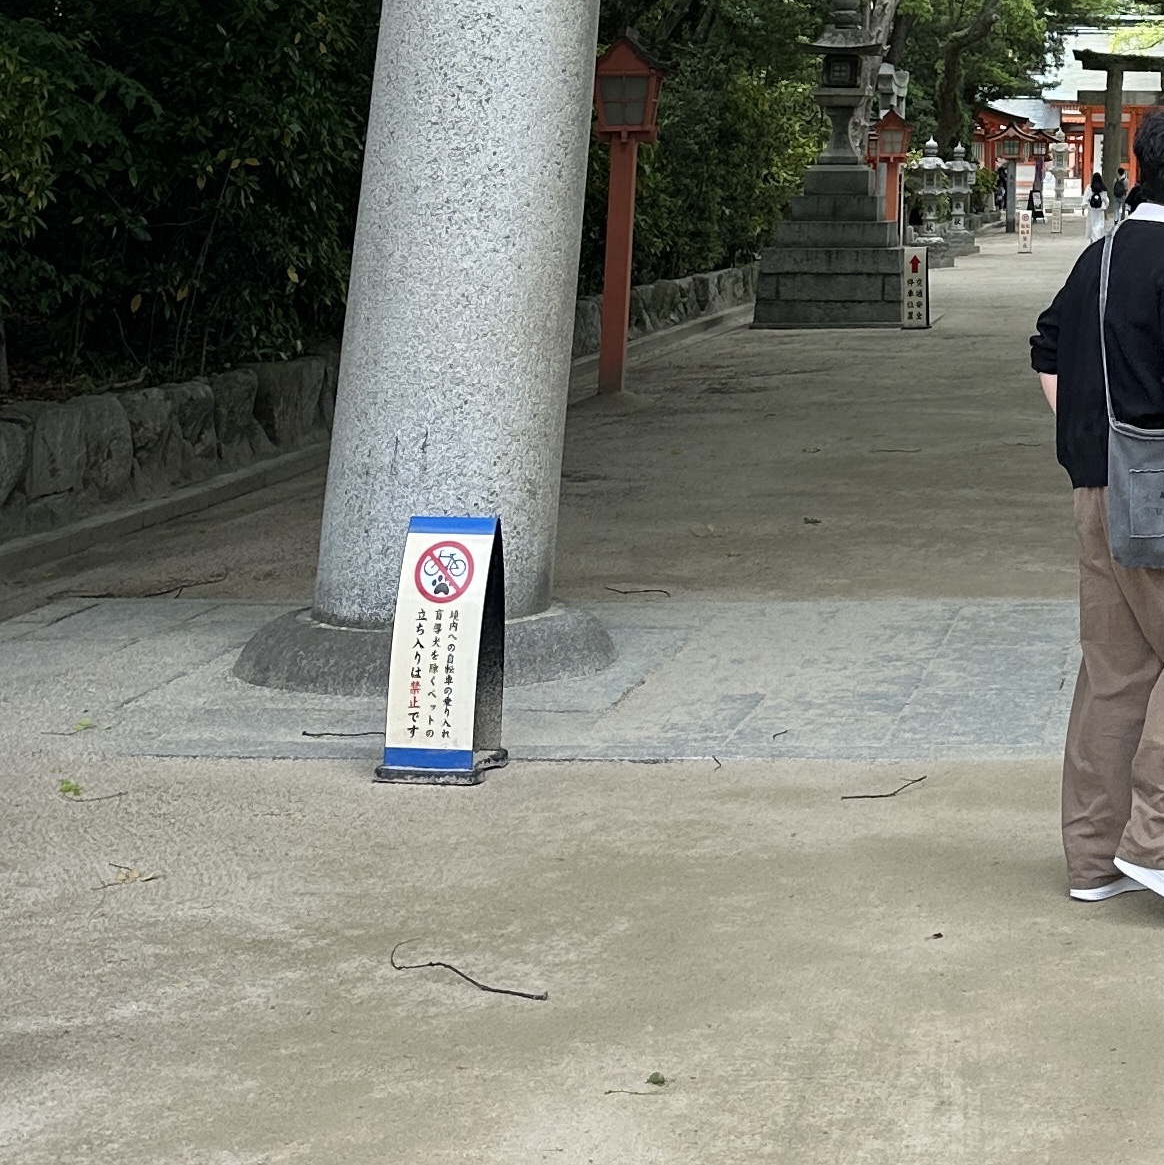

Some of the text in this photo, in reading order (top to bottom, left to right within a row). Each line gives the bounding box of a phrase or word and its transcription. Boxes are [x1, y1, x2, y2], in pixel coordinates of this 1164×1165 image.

[906, 278, 914, 320] 停車位置
[915, 278, 923, 320] 交通安全
[407, 608, 427, 738] 立ち入りは禁止です
[441, 609, 459, 739] 境内への自転車の乗り入れ
